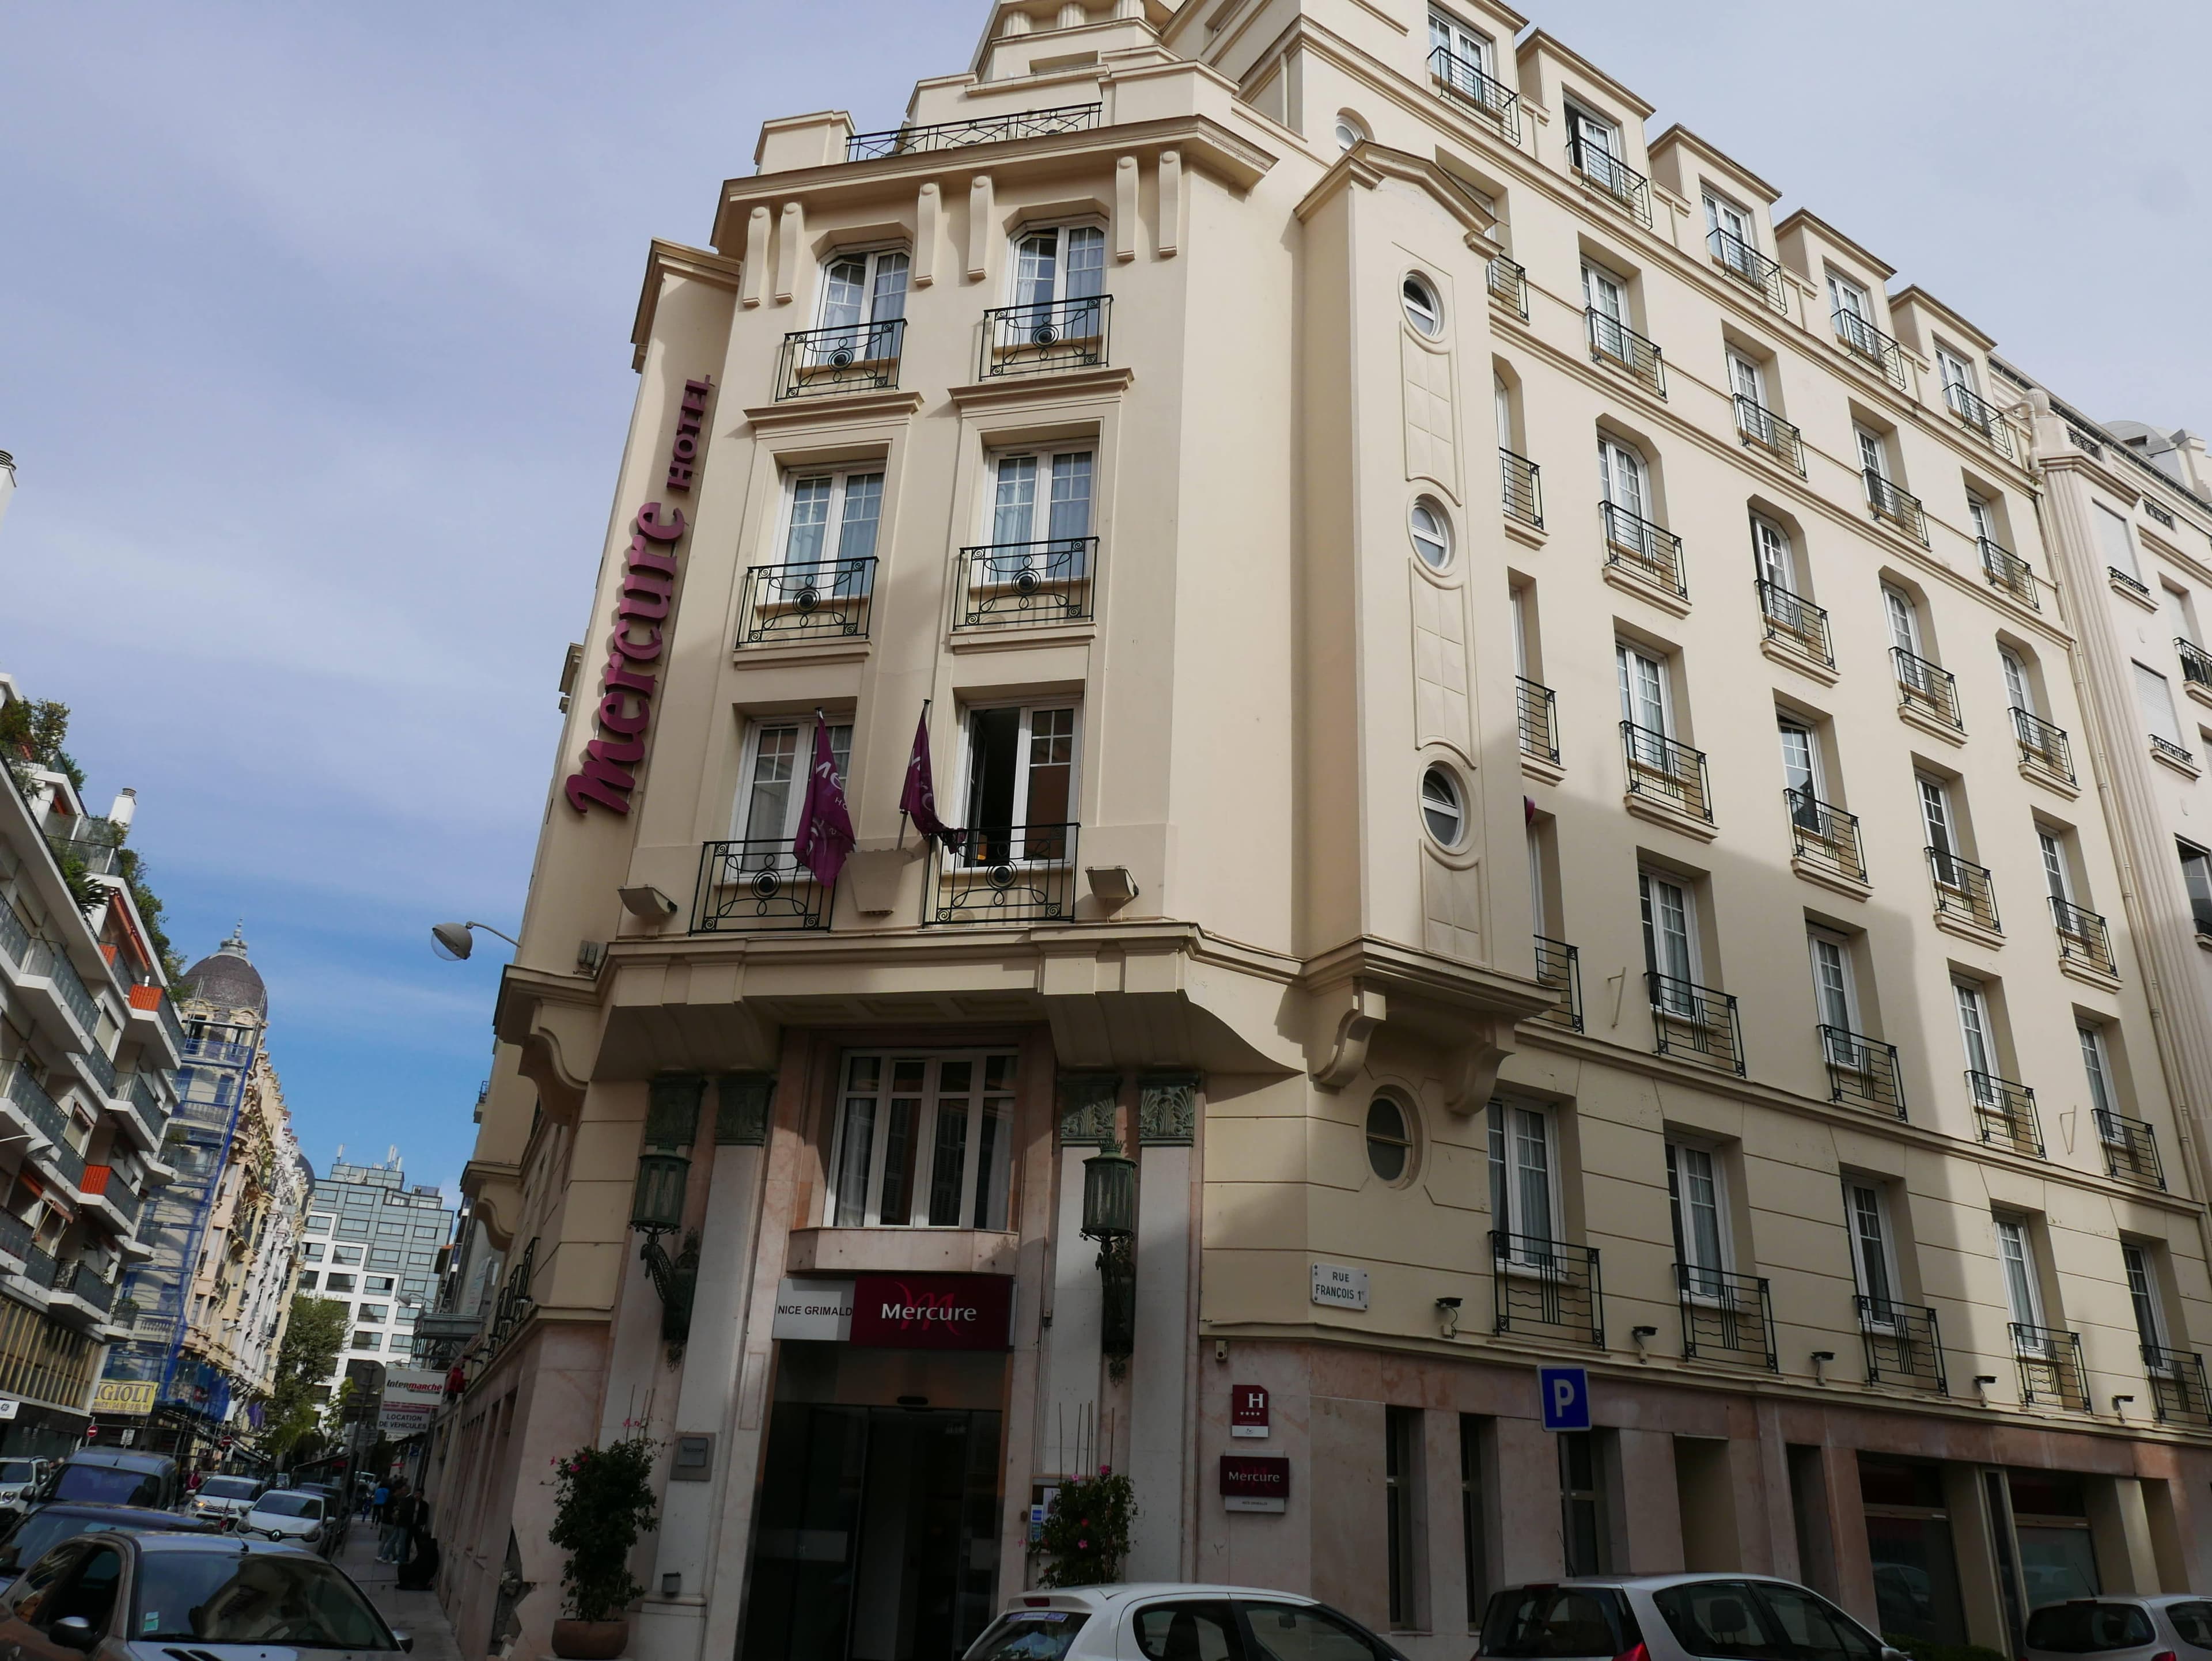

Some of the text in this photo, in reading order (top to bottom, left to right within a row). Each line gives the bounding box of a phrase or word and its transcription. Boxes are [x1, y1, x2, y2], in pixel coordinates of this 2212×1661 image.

[566, 374, 710, 816] Mercure HOTEL
[1332, 1271, 1350, 1283] RUE
[1316, 1284, 1354, 1300] FRANÇOIS
[778, 1305, 802, 1315] NICE
[881, 1303, 977, 1322] Mercure
[1248, 1393, 1264, 1408] H
[1553, 1379, 1574, 1418] P
[386, 1413, 422, 1421] LOCATION
[1229, 1472, 1280, 1482] Mercure
